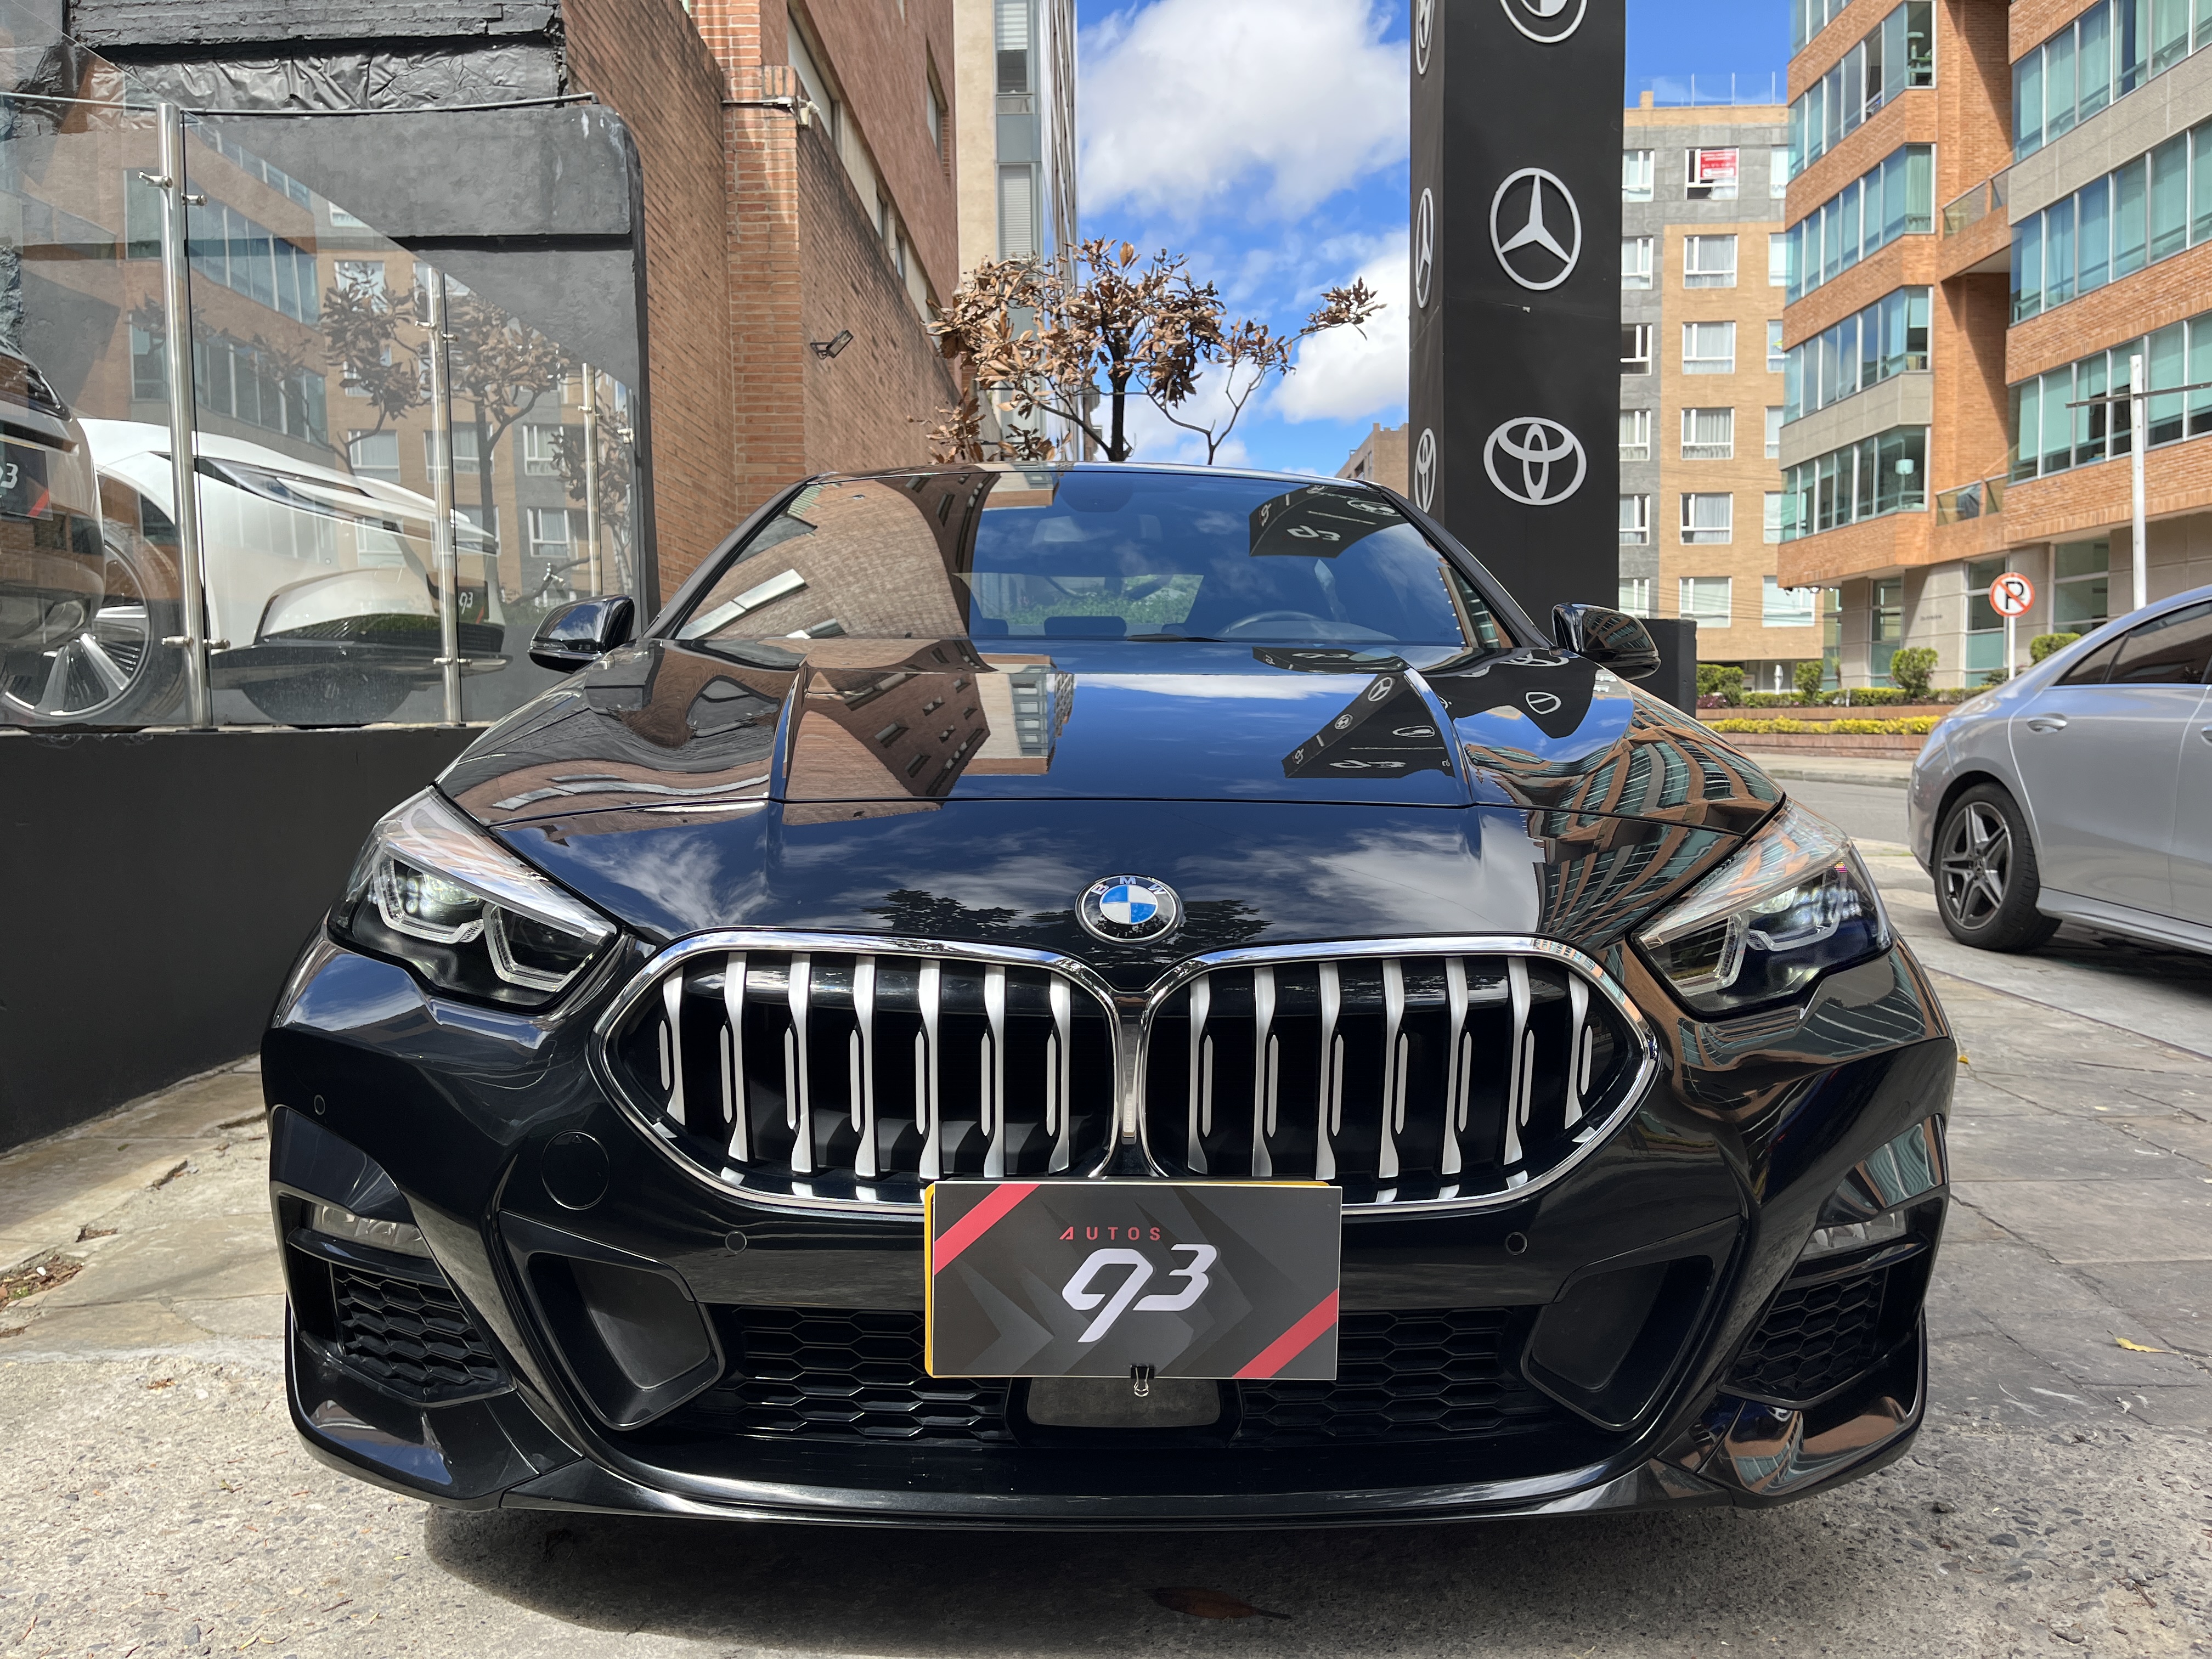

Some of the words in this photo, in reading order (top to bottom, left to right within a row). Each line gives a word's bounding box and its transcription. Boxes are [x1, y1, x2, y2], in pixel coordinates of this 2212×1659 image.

[0, 462, 19, 489] 3
[459, 591, 473, 614] 93
[2005, 582, 2024, 610] P
[1091, 876, 1166, 895] BMW
[1059, 1226, 1161, 1241] AUTOS
[1062, 1243, 1218, 1342] 93
